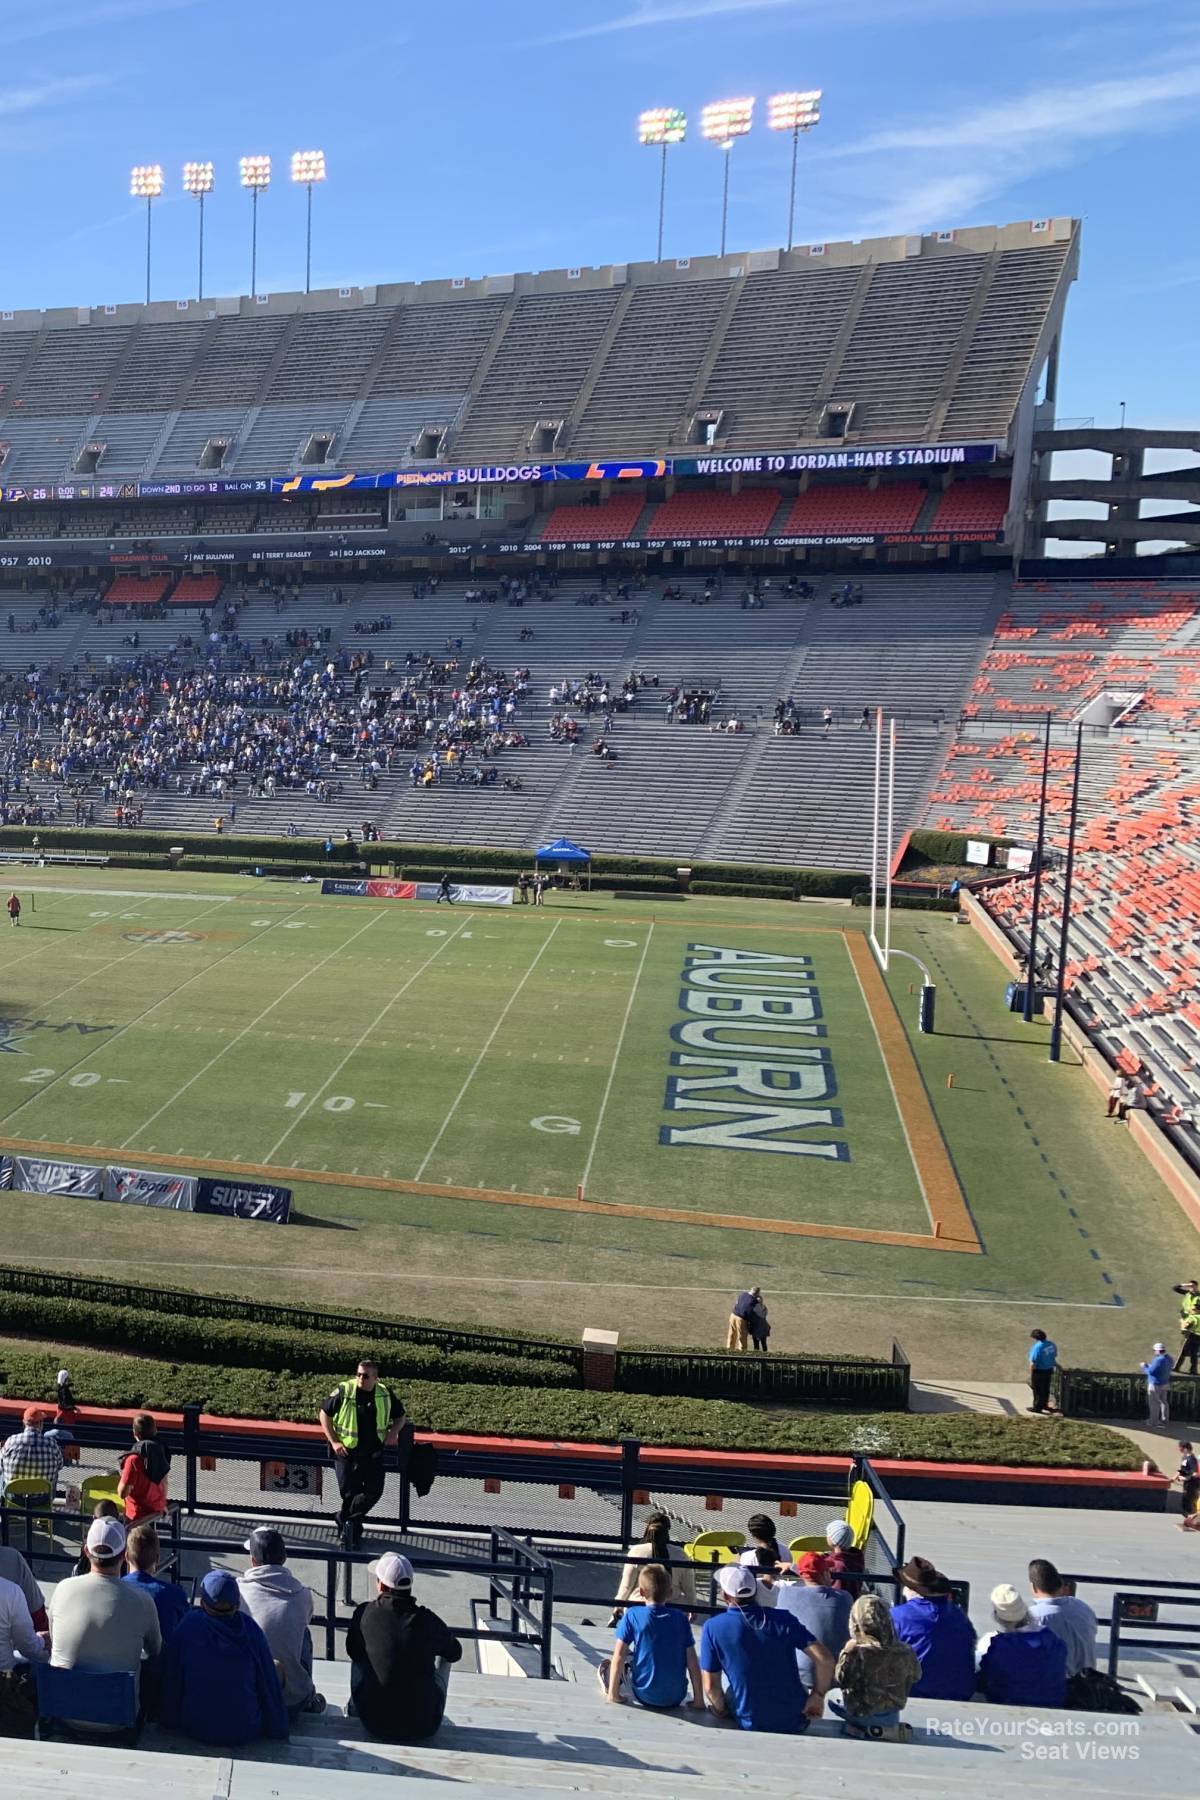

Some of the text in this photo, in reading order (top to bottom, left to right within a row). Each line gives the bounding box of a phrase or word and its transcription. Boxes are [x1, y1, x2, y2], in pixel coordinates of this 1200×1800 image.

[1034, 221, 1046, 229] 47
[939, 232, 951, 240] 48
[677, 259, 689, 267] 50
[569, 269, 579, 277] 51
[697, 446, 965, 474] WELCOME TO JORDAN-HARE STADIUM
[396, 466, 541, 485] PIEDMONT BULLDOGS
[58, 486, 74, 495] 0:00
[99, 486, 113, 497] 24
[142, 486, 164, 494] DOWN
[165, 484, 180, 494] 2ND
[193, 484, 205, 492] GO
[208, 483, 218, 492] 12
[224, 482, 238, 490] BALL
[240, 482, 251, 490] ON
[255, 481, 266, 490] 35
[32, 488, 47, 499] 26
[597, 542, 615, 550] 1987
[621, 541, 641, 550] 1983
[672, 540, 691, 548] 1932
[724, 539, 743, 547] 1914
[750, 538, 770, 546] 1913
[773, 537, 823, 546] CONFERENCE
[825, 535, 875, 544] CHAMPIONS
[883, 532, 996, 544] JORDAN HARE STADIUM
[205, 553, 235, 561] SULLIVAN
[266, 551, 284, 559] TERRY
[285, 551, 312, 559] BEASLEY
[354, 549, 386, 557] JACKSON
[27, 556, 52, 566] 2010
[658, 942, 850, 1162] AUBURN
[19, 1067, 104, 1088] 20
[283, 1091, 356, 1112] 10
[529, 1115, 582, 1136] G
